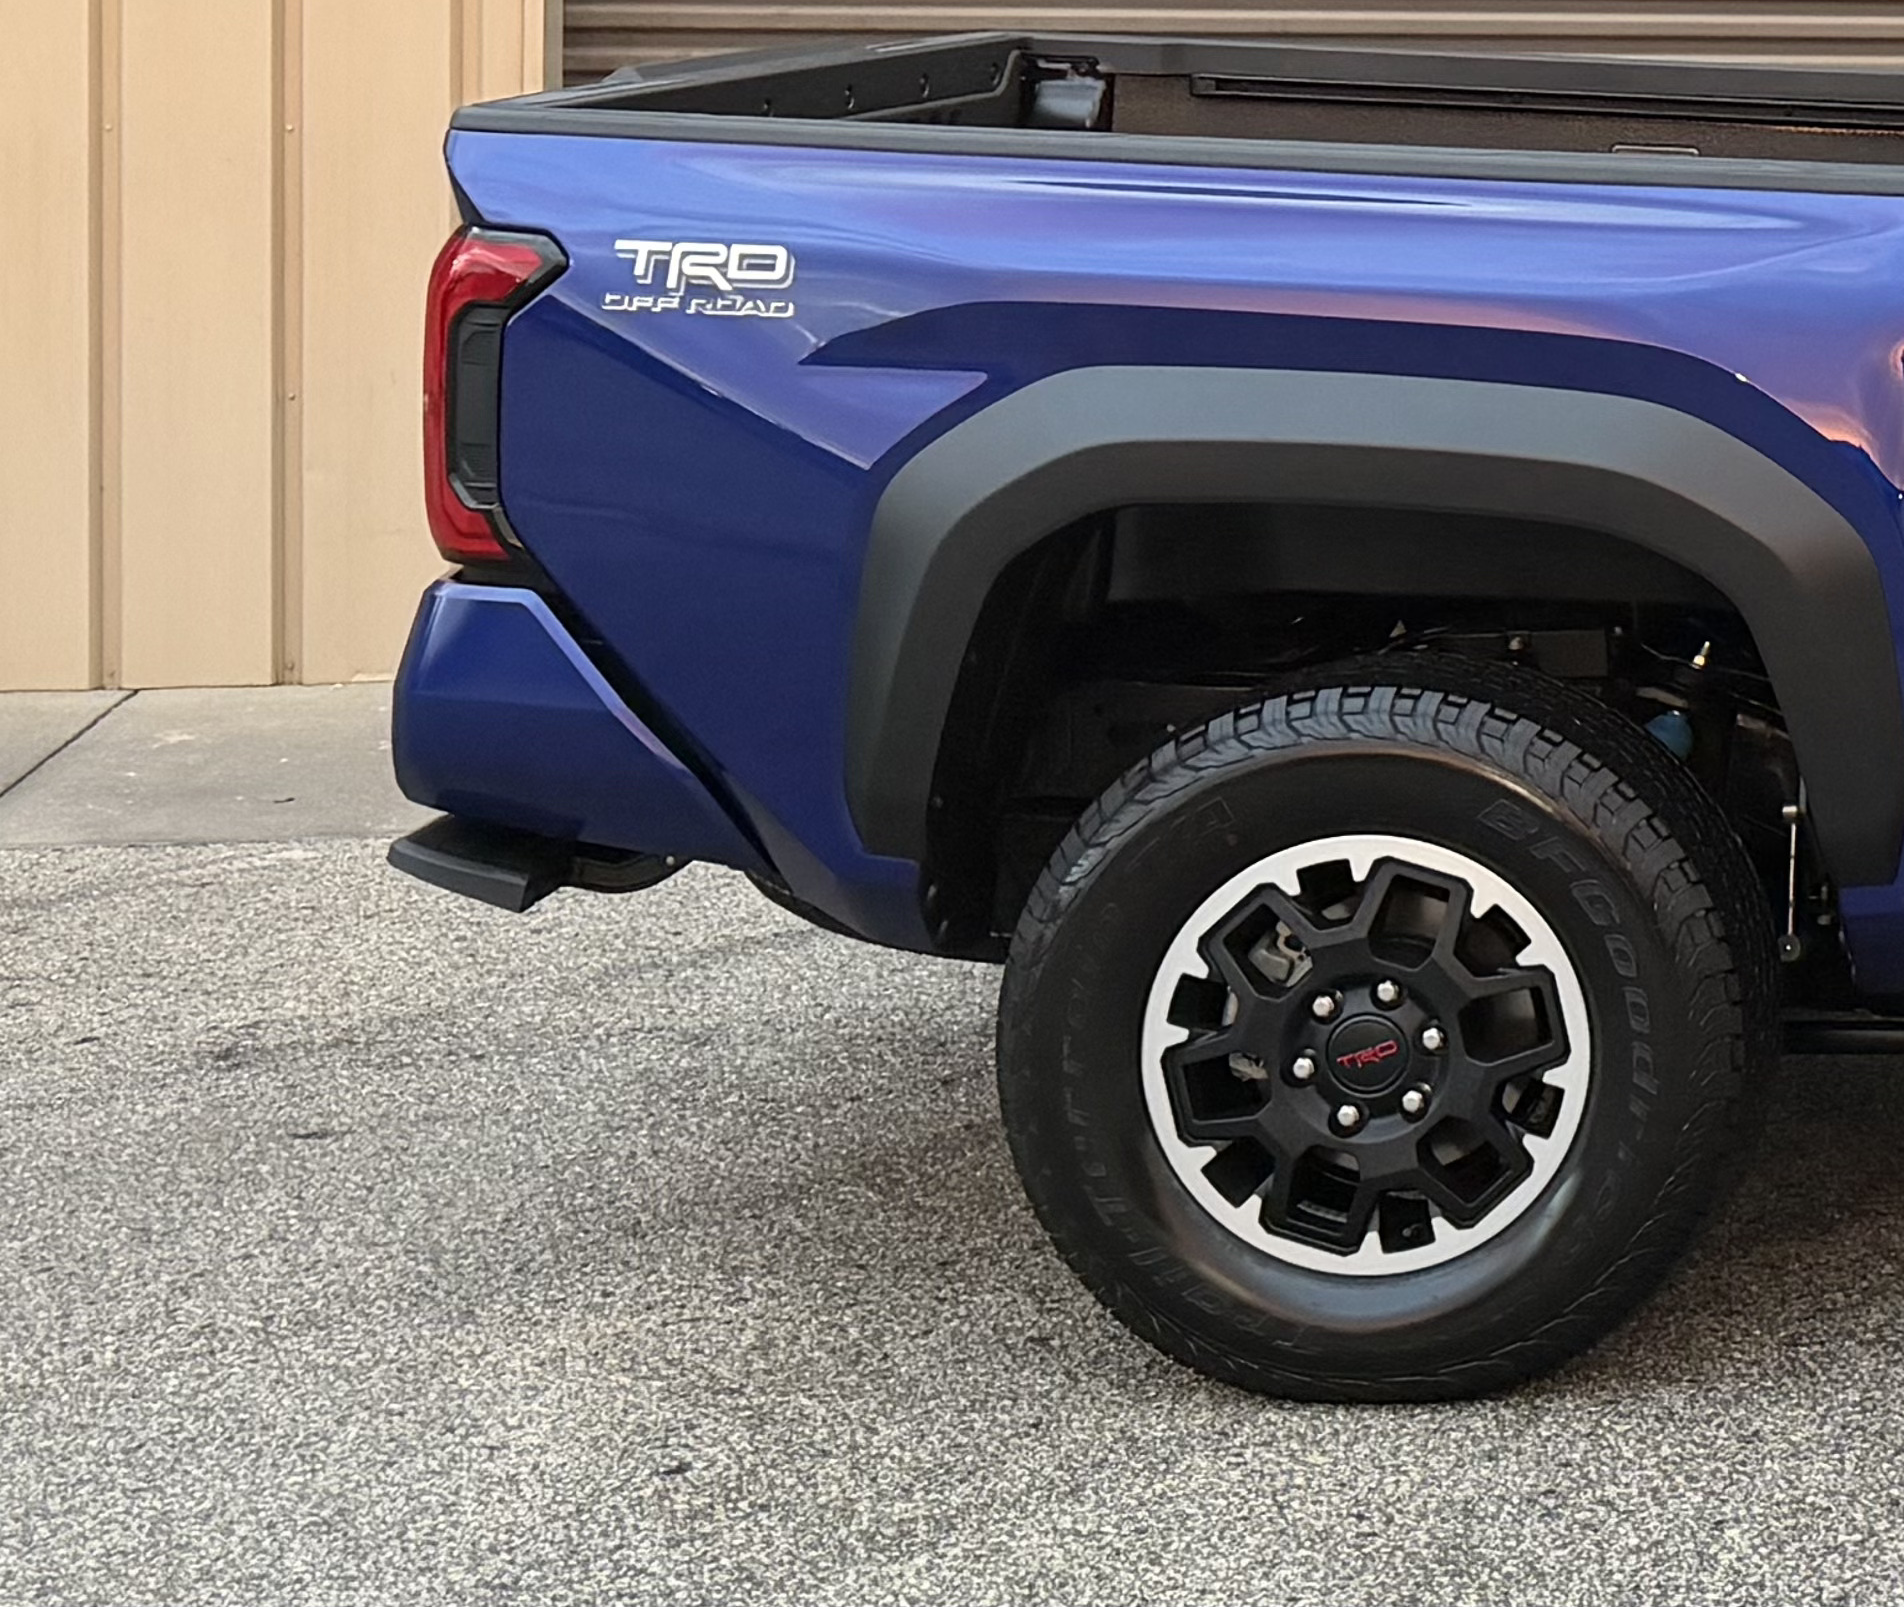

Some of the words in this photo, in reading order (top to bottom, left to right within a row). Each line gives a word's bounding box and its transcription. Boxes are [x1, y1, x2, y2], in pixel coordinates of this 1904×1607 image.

[614, 239, 796, 293] TRD
[601, 292, 681, 312] OFF
[685, 296, 794, 318] ROAD
[1336, 1039, 1399, 1070] TRD
